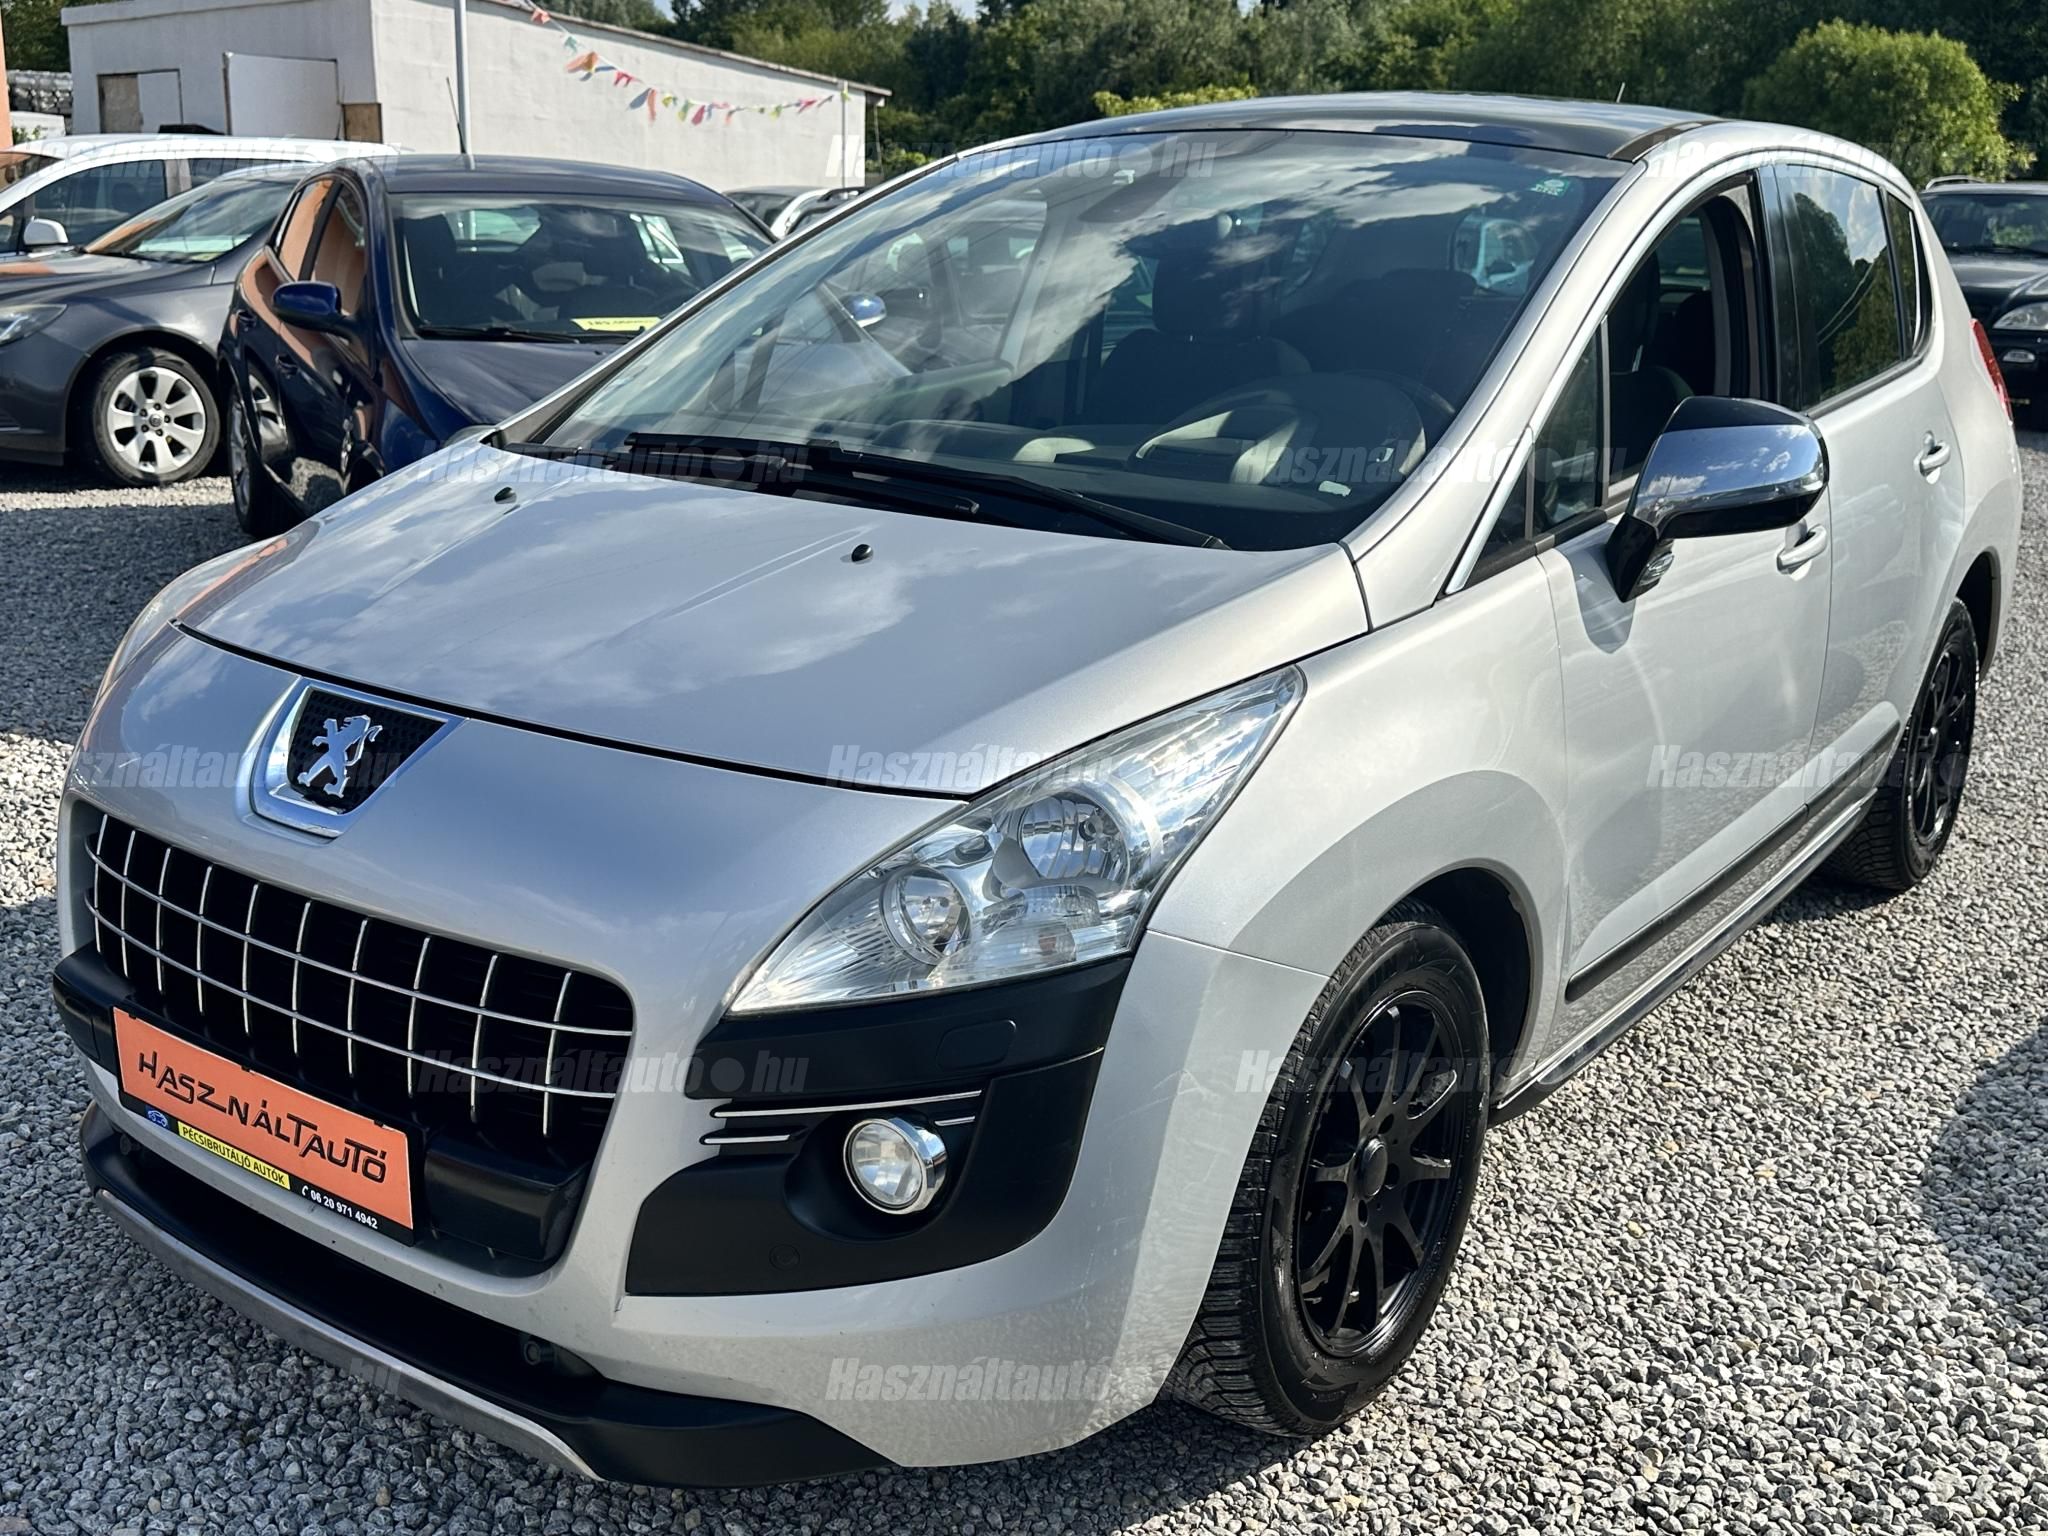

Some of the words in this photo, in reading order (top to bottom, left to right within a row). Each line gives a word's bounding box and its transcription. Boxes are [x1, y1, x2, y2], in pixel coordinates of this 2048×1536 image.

[253, 1162, 286, 1186] AUTÓK
[310, 1189, 322, 1203] 06
[323, 1195, 335, 1209] 20
[336, 1201, 353, 1218] 971
[355, 1209, 379, 1230] 4942
